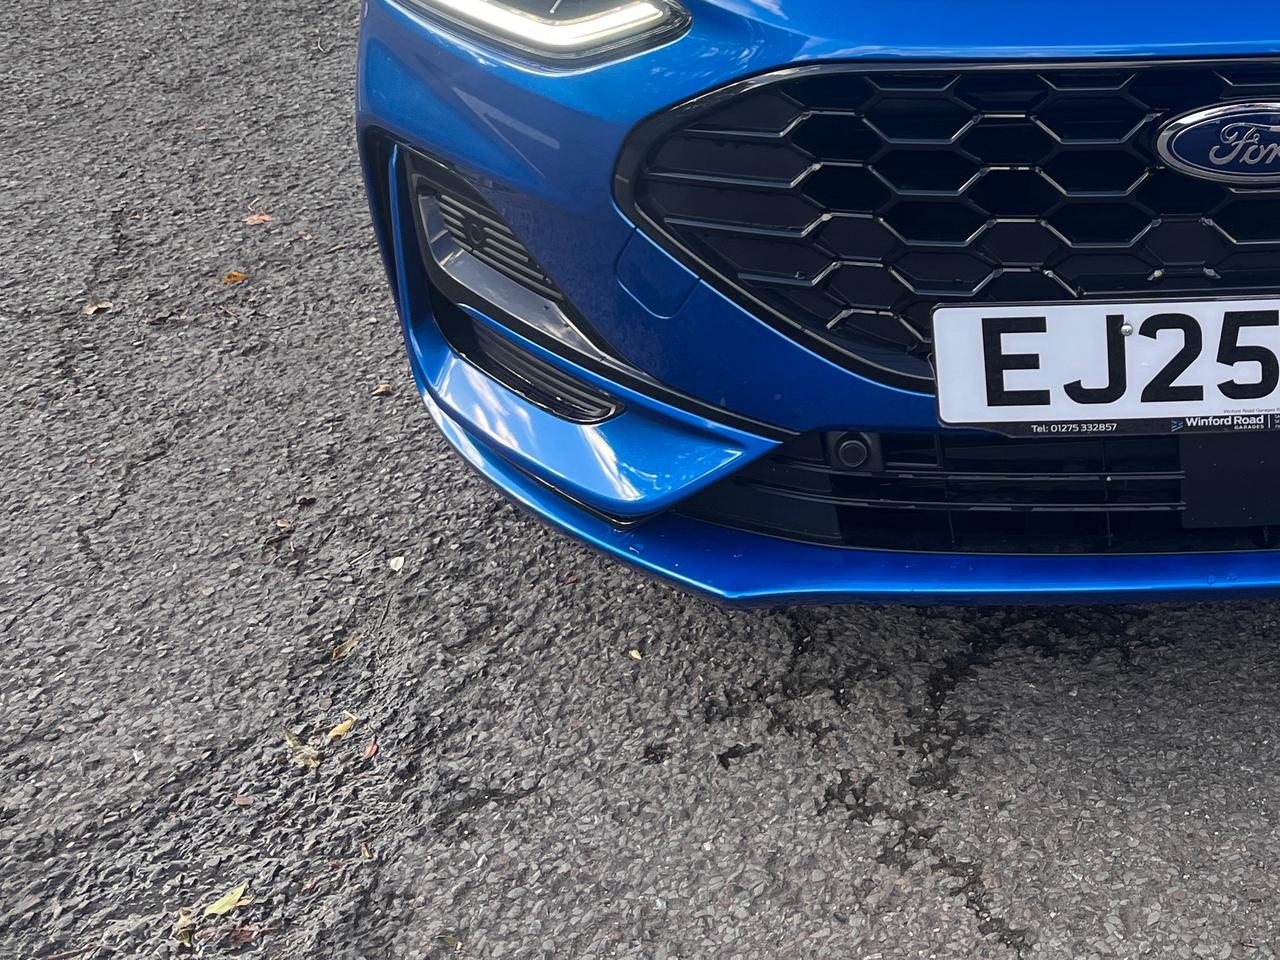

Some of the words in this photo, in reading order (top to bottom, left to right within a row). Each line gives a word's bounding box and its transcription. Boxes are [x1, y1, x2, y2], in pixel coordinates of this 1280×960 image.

[981, 309, 1280, 407] EJ25
[1185, 415, 1232, 427] Winford
[1233, 415, 1264, 425] Road
[1031, 424, 1049, 433] Tel:
[1050, 424, 1079, 432] 01275
[1080, 423, 1117, 432] 332857
